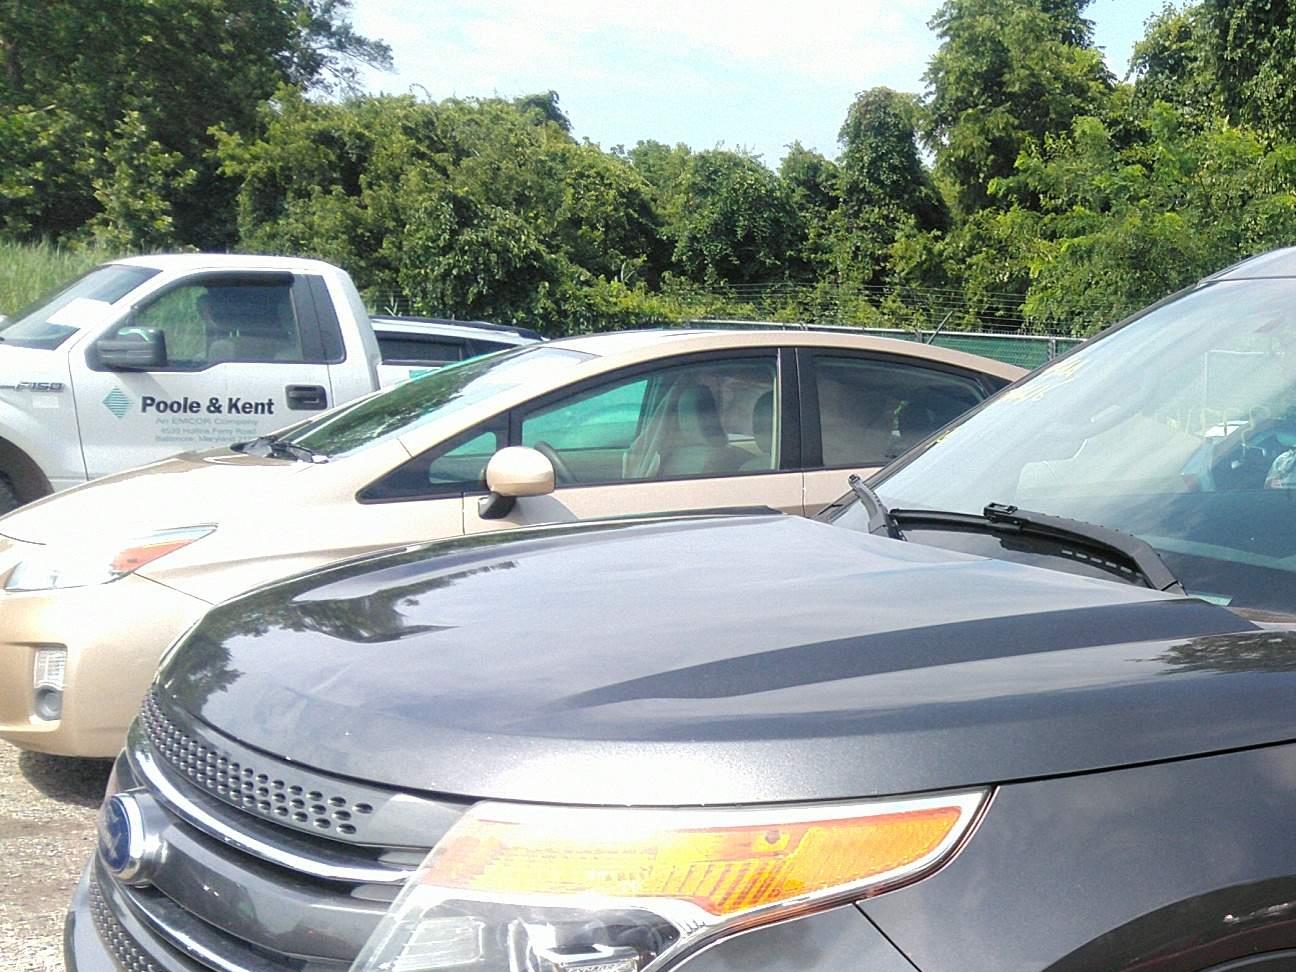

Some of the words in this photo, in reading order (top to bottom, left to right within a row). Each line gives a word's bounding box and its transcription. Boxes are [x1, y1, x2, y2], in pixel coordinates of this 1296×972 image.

[141, 396, 201, 414] Poole
[206, 397, 223, 414] &
[227, 397, 275, 415] Kent
[172, 417, 211, 425] EMCOR
[214, 418, 258, 427] Company
